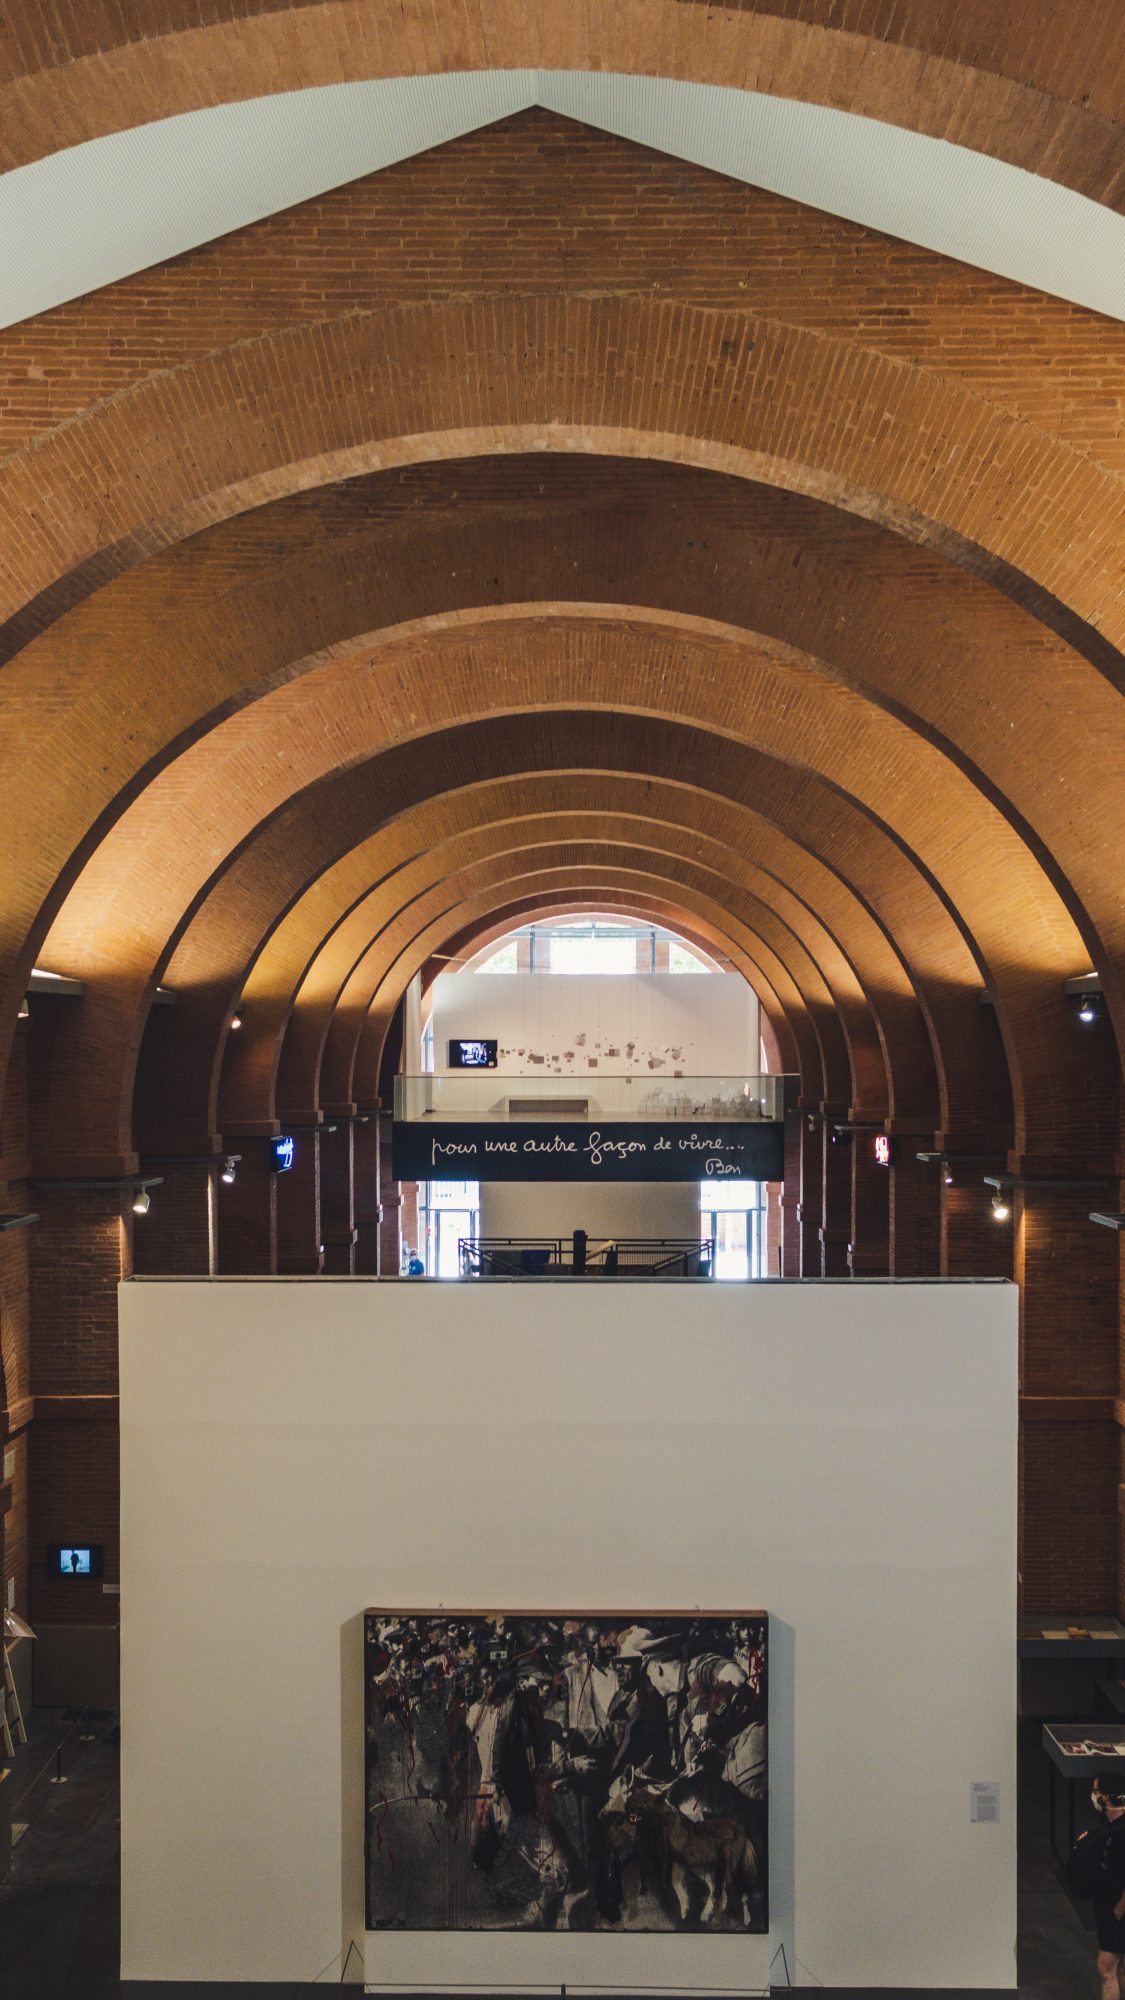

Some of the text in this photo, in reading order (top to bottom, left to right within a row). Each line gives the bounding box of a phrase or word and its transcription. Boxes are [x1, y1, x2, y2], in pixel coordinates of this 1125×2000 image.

[431, 1138, 477, 1166] pour
[484, 1140, 518, 1153] une
[523, 1134, 578, 1153] autre
[583, 1131, 647, 1165] façon
[653, 1136, 672, 1151] de
